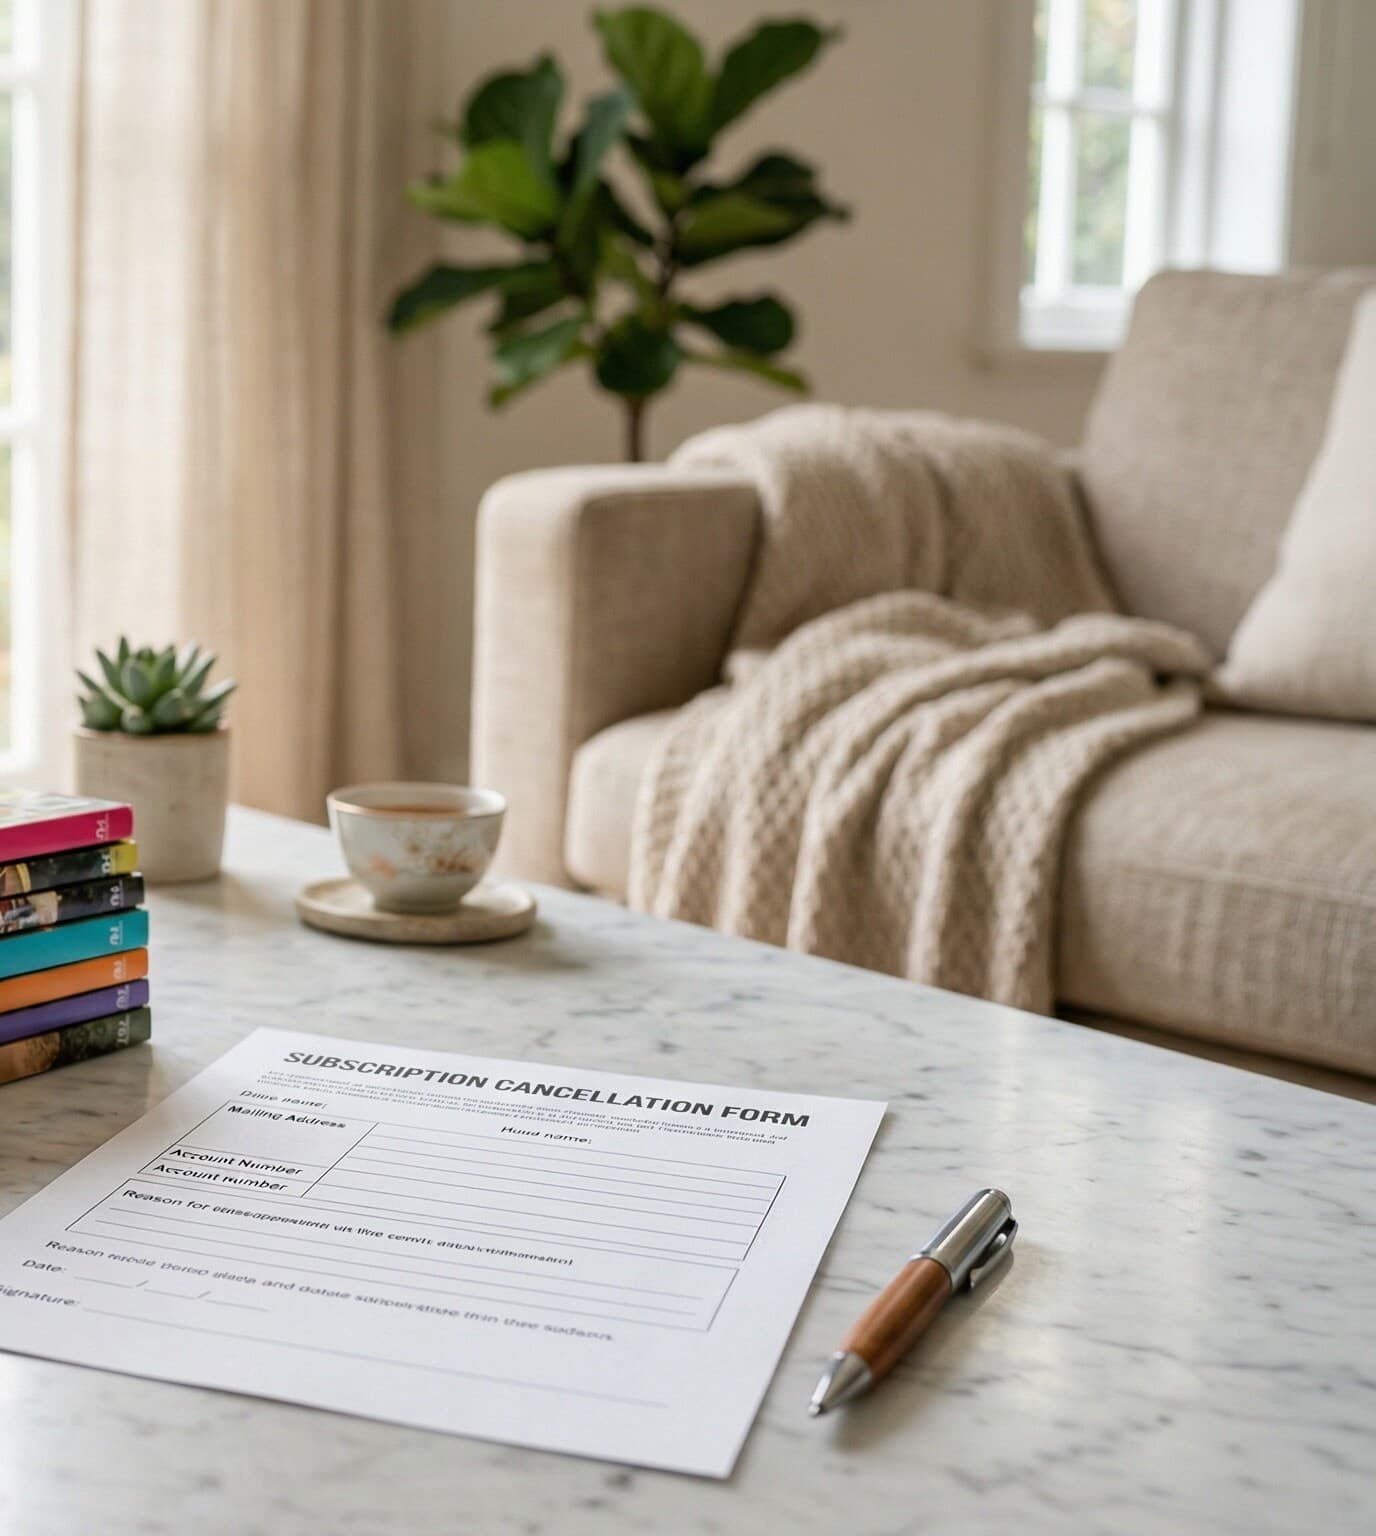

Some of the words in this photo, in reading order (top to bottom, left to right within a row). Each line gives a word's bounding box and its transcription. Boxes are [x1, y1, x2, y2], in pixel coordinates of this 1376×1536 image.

[283, 1052, 489, 1088] SUBSCRIPTION
[494, 1079, 713, 1116] CANCELLATION
[721, 1105, 811, 1128] FORM
[227, 1105, 283, 1121] Mailing
[284, 1113, 346, 1129] Address
[153, 1164, 220, 1181] Account
[169, 1149, 236, 1165] Account
[238, 1158, 304, 1175] Number
[122, 1189, 183, 1206] Reason
[186, 1200, 210, 1211] for
[44, 1239, 105, 1257] Reason
[21, 1259, 68, 1273] Date:
